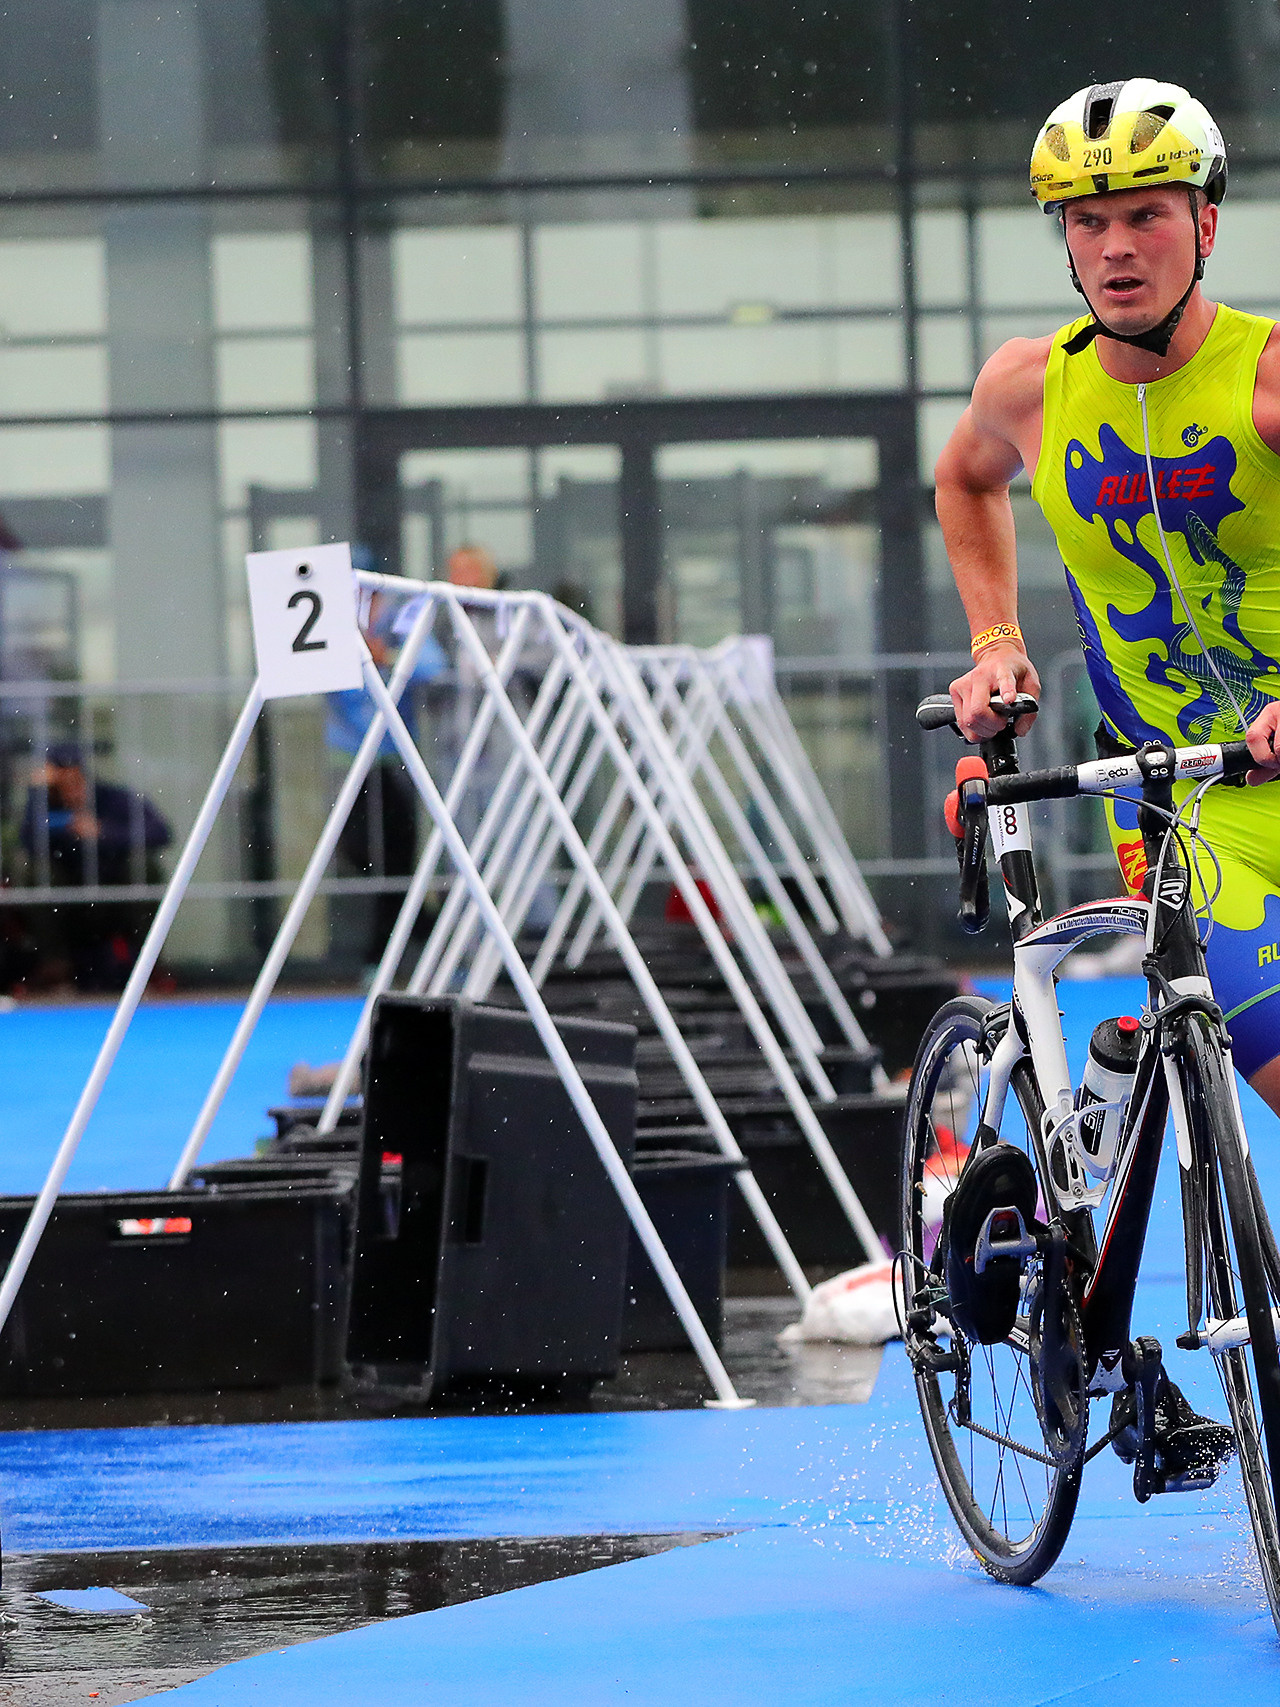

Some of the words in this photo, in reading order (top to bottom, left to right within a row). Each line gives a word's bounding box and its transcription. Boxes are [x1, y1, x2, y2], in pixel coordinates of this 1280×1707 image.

[1083, 147, 1112, 168] 290
[286, 590, 327, 653] 2
[1110, 907, 1147, 921] NOAH
